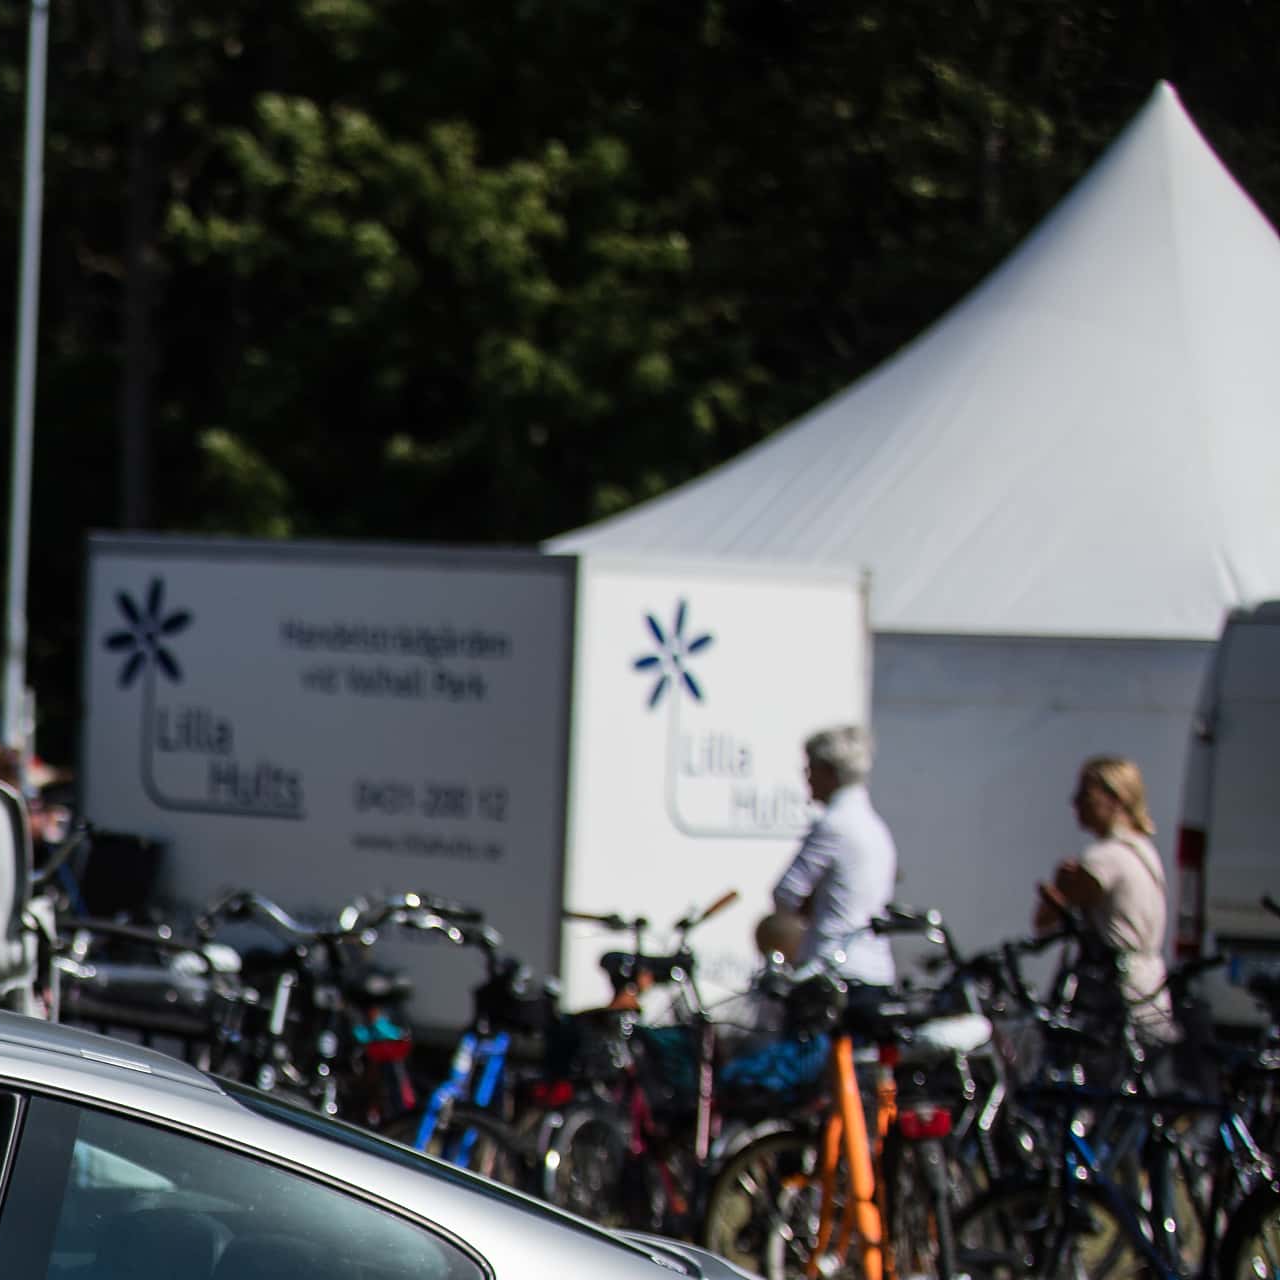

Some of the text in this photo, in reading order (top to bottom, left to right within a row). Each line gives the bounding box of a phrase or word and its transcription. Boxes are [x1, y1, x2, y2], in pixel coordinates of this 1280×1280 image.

[156, 704, 234, 754] Lilla
[676, 733, 752, 778] Lilla
[211, 760, 305, 811] Hults
